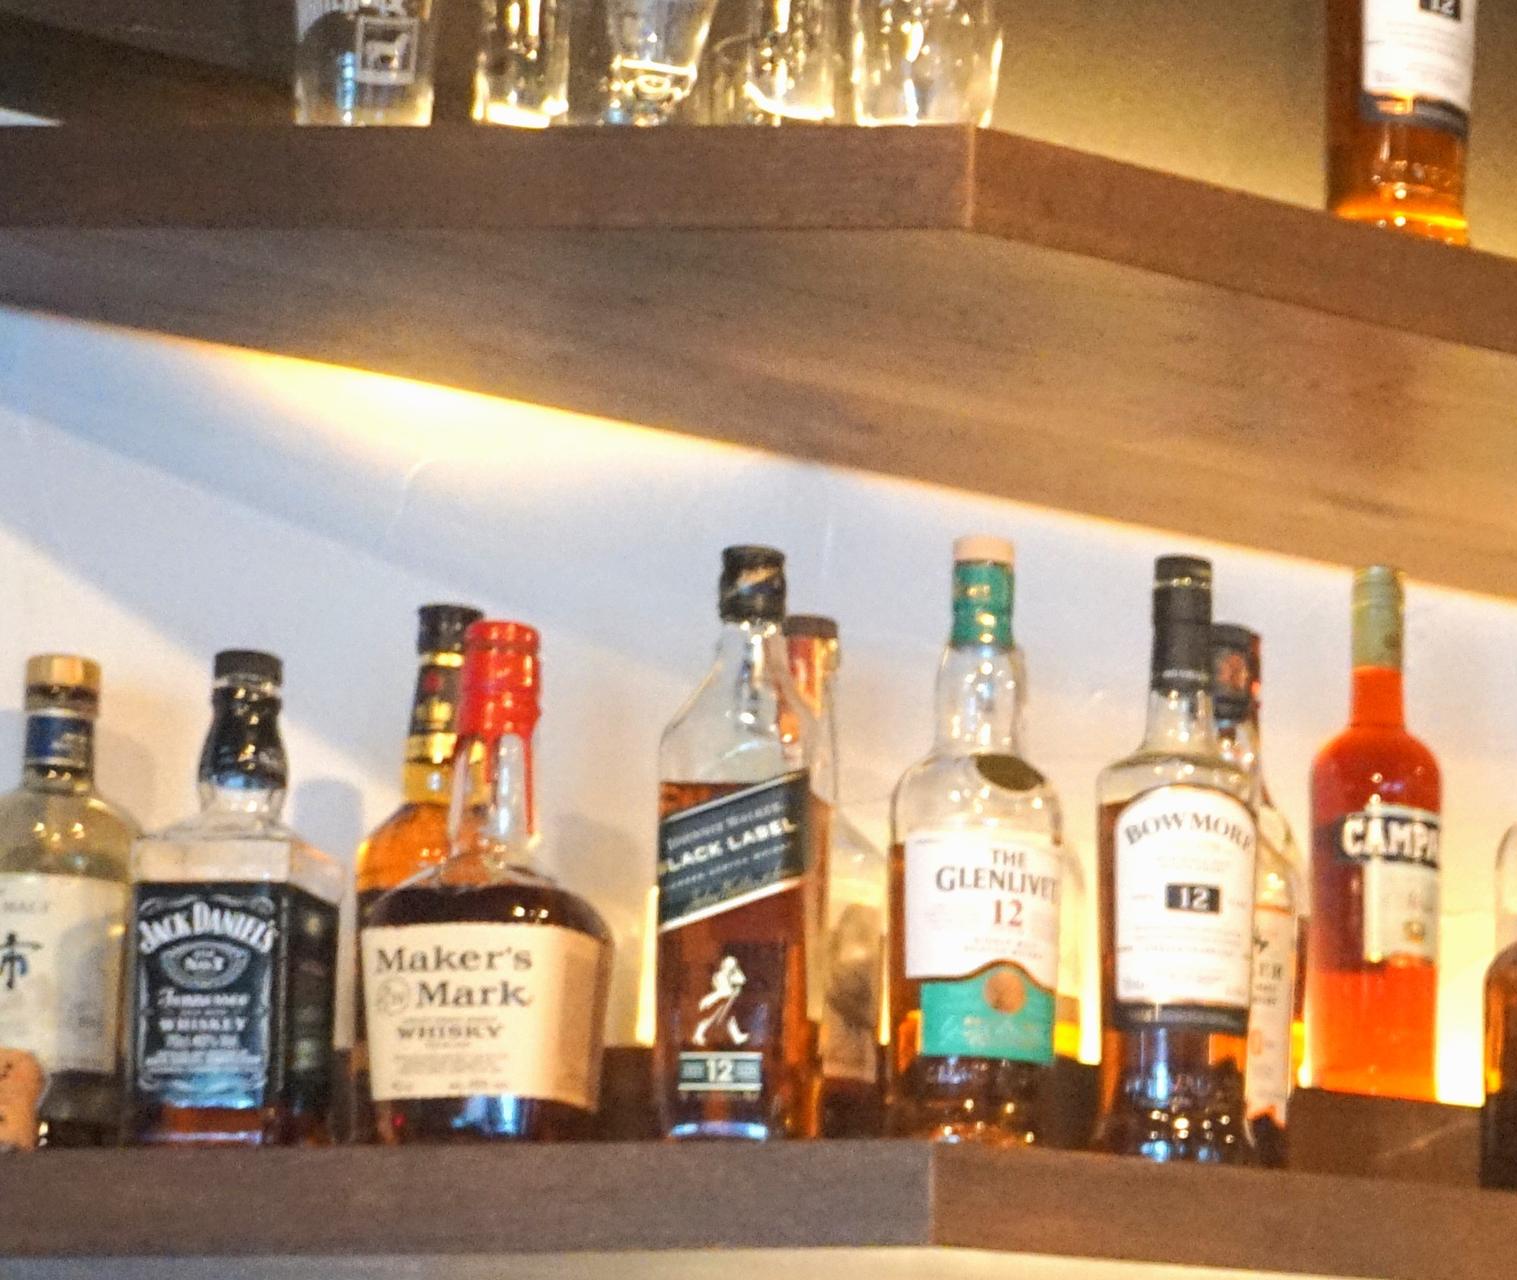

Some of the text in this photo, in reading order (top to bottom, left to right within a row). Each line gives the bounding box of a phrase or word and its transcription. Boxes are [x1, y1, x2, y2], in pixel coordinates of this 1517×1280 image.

[657, 840, 724, 874] LACK
[726, 817, 797, 851] LABEL
[992, 849, 1027, 868] THE
[993, 899, 1024, 928] 12
[1181, 886, 1211, 914] 12
[139, 912, 193, 953] JACK
[376, 946, 533, 973] Maker's
[416, 981, 534, 1008] Mark
[397, 1022, 505, 1040] WHISKY
[707, 1060, 735, 1082] 12
